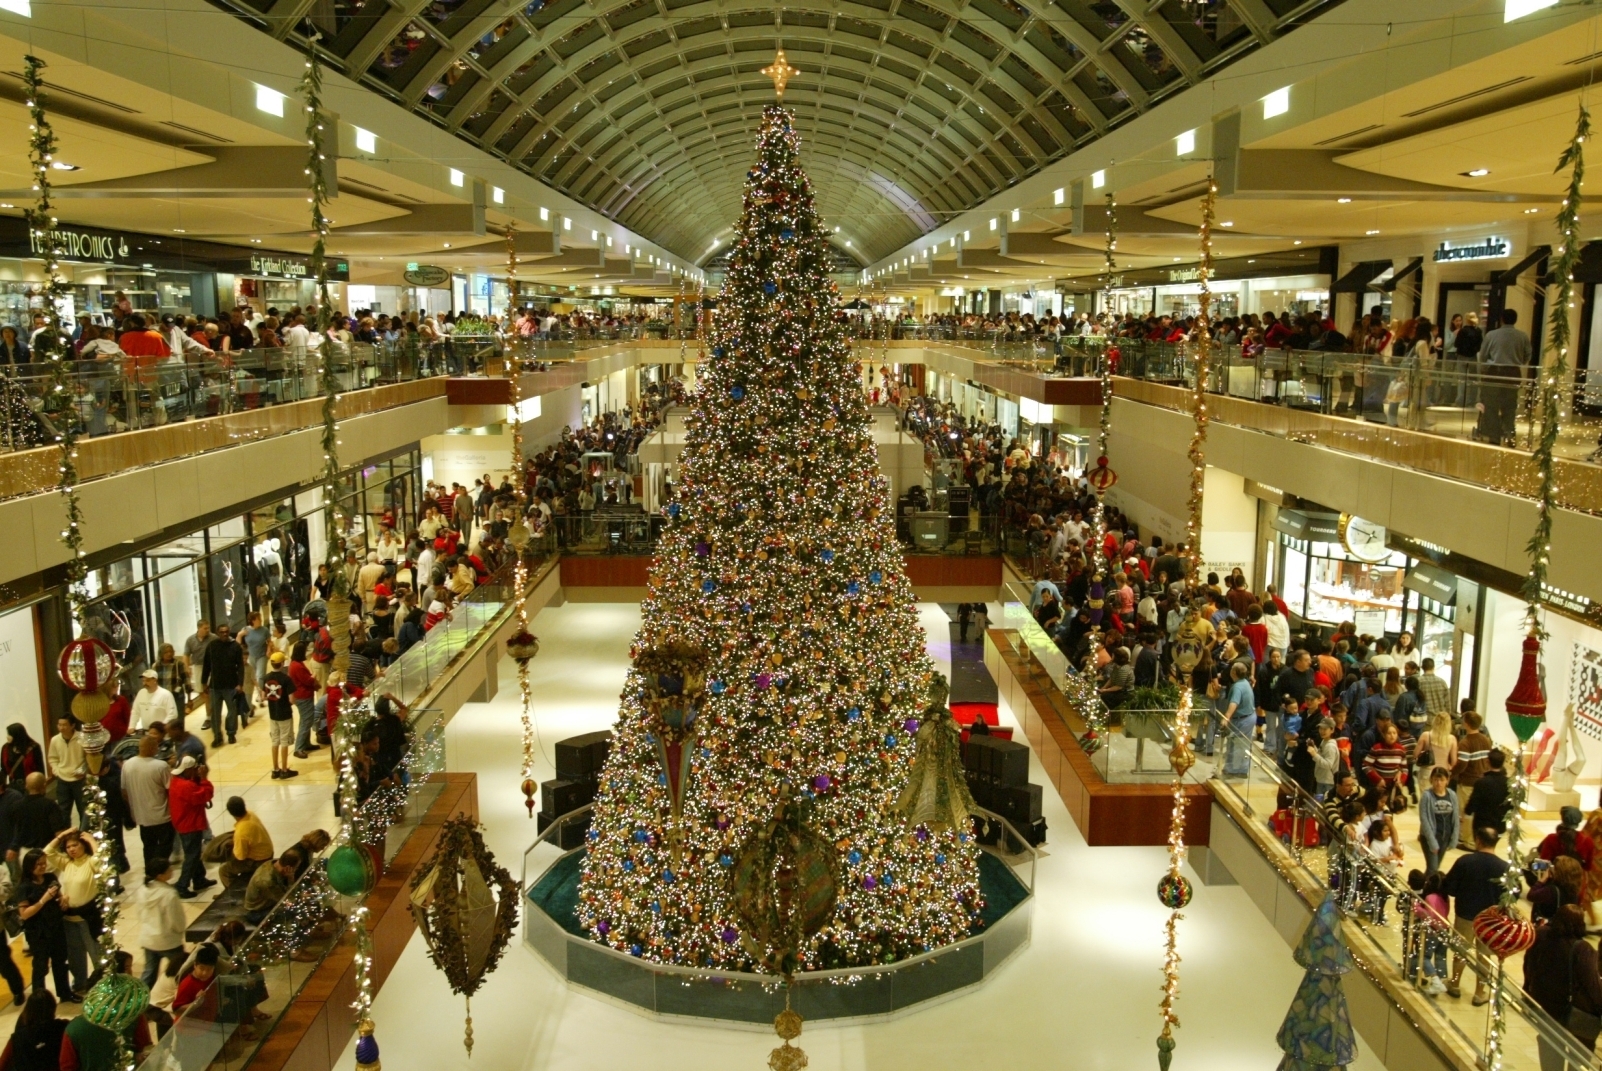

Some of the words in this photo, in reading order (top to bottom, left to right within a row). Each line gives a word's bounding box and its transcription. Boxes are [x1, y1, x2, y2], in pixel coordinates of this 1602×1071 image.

[1432, 237, 1507, 261] abercrombie
[282, 260, 306, 275] Collection
[1309, 526, 1337, 535] TOURNEAU
[1549, 594, 1564, 606] PARIS
[1565, 600, 1586, 614] LONDON
